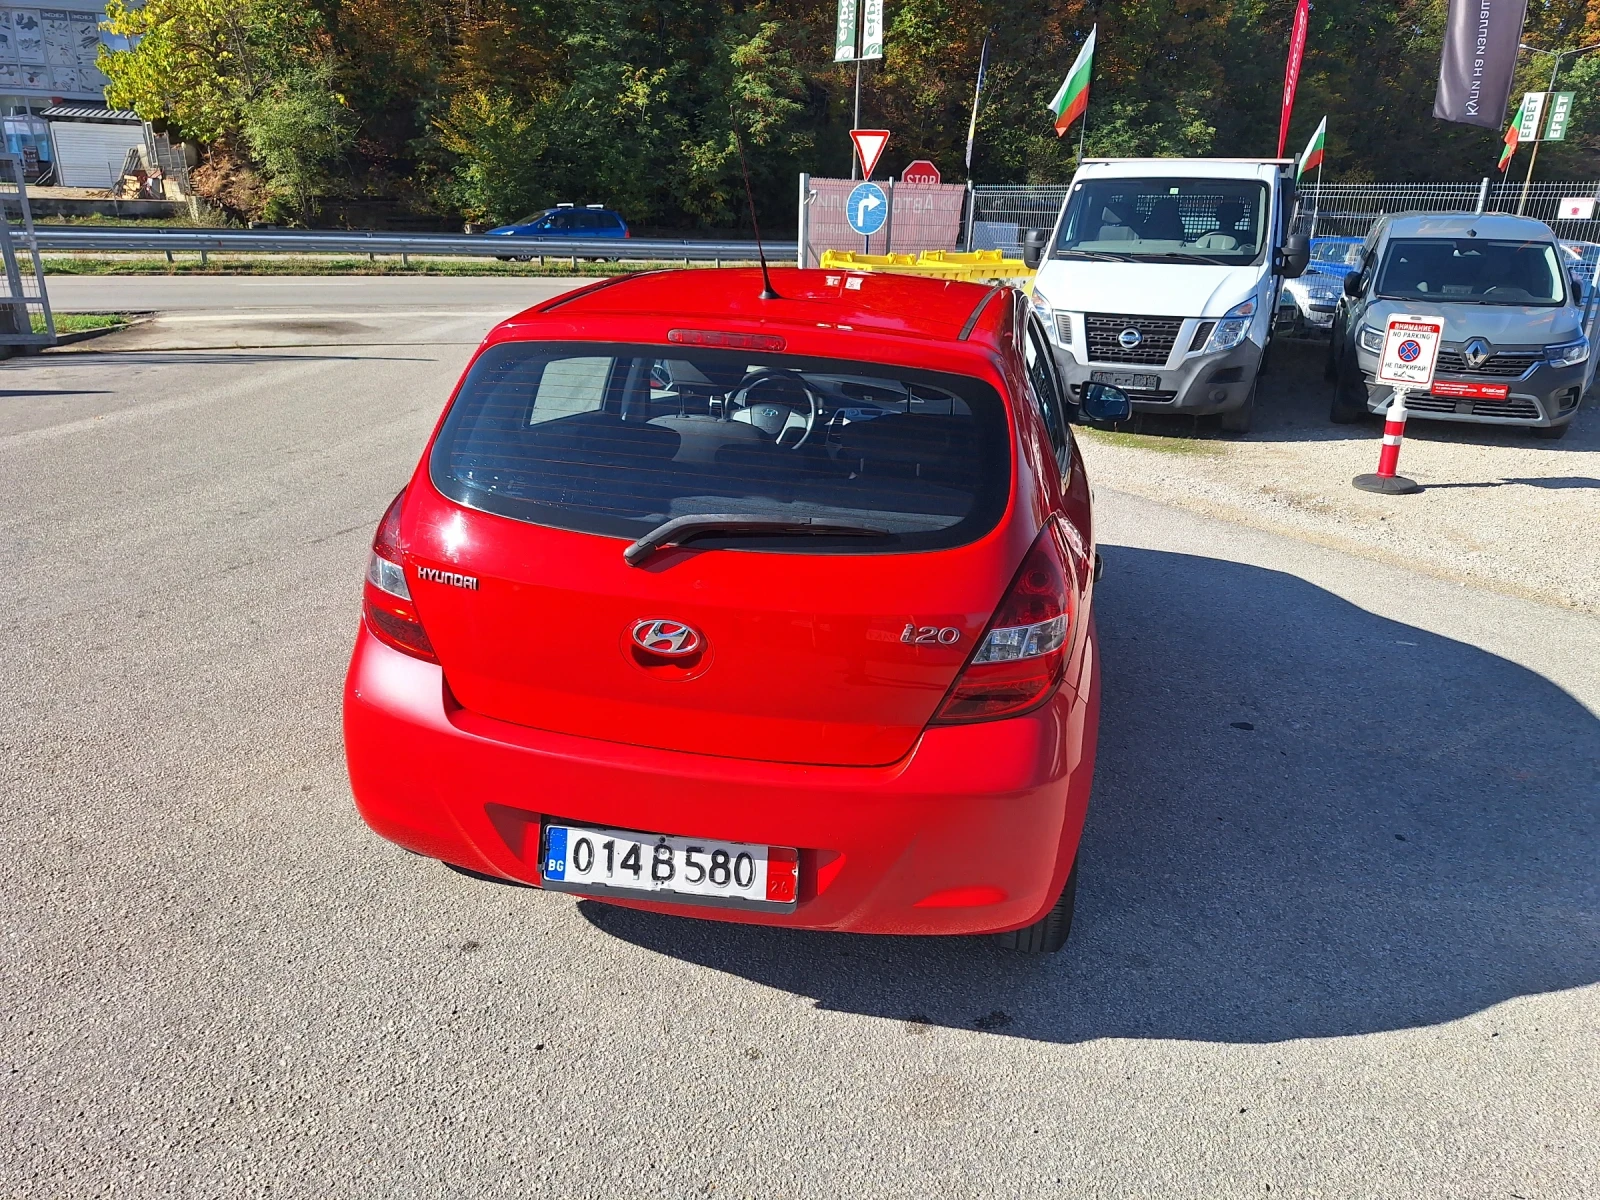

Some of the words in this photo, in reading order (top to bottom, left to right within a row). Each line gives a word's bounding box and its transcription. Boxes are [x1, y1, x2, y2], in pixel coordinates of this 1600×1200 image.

[1521, 96, 1538, 138] EFBET
[1549, 95, 1569, 138] EFBET
[906, 174, 936, 184] STOP
[1394, 322, 1435, 333] ВНИМАНИЕ!
[1403, 332, 1434, 340] PARKING!
[417, 565, 479, 591] HYUNDAI
[900, 623, 960, 645] i20
[547, 858, 565, 872] BG
